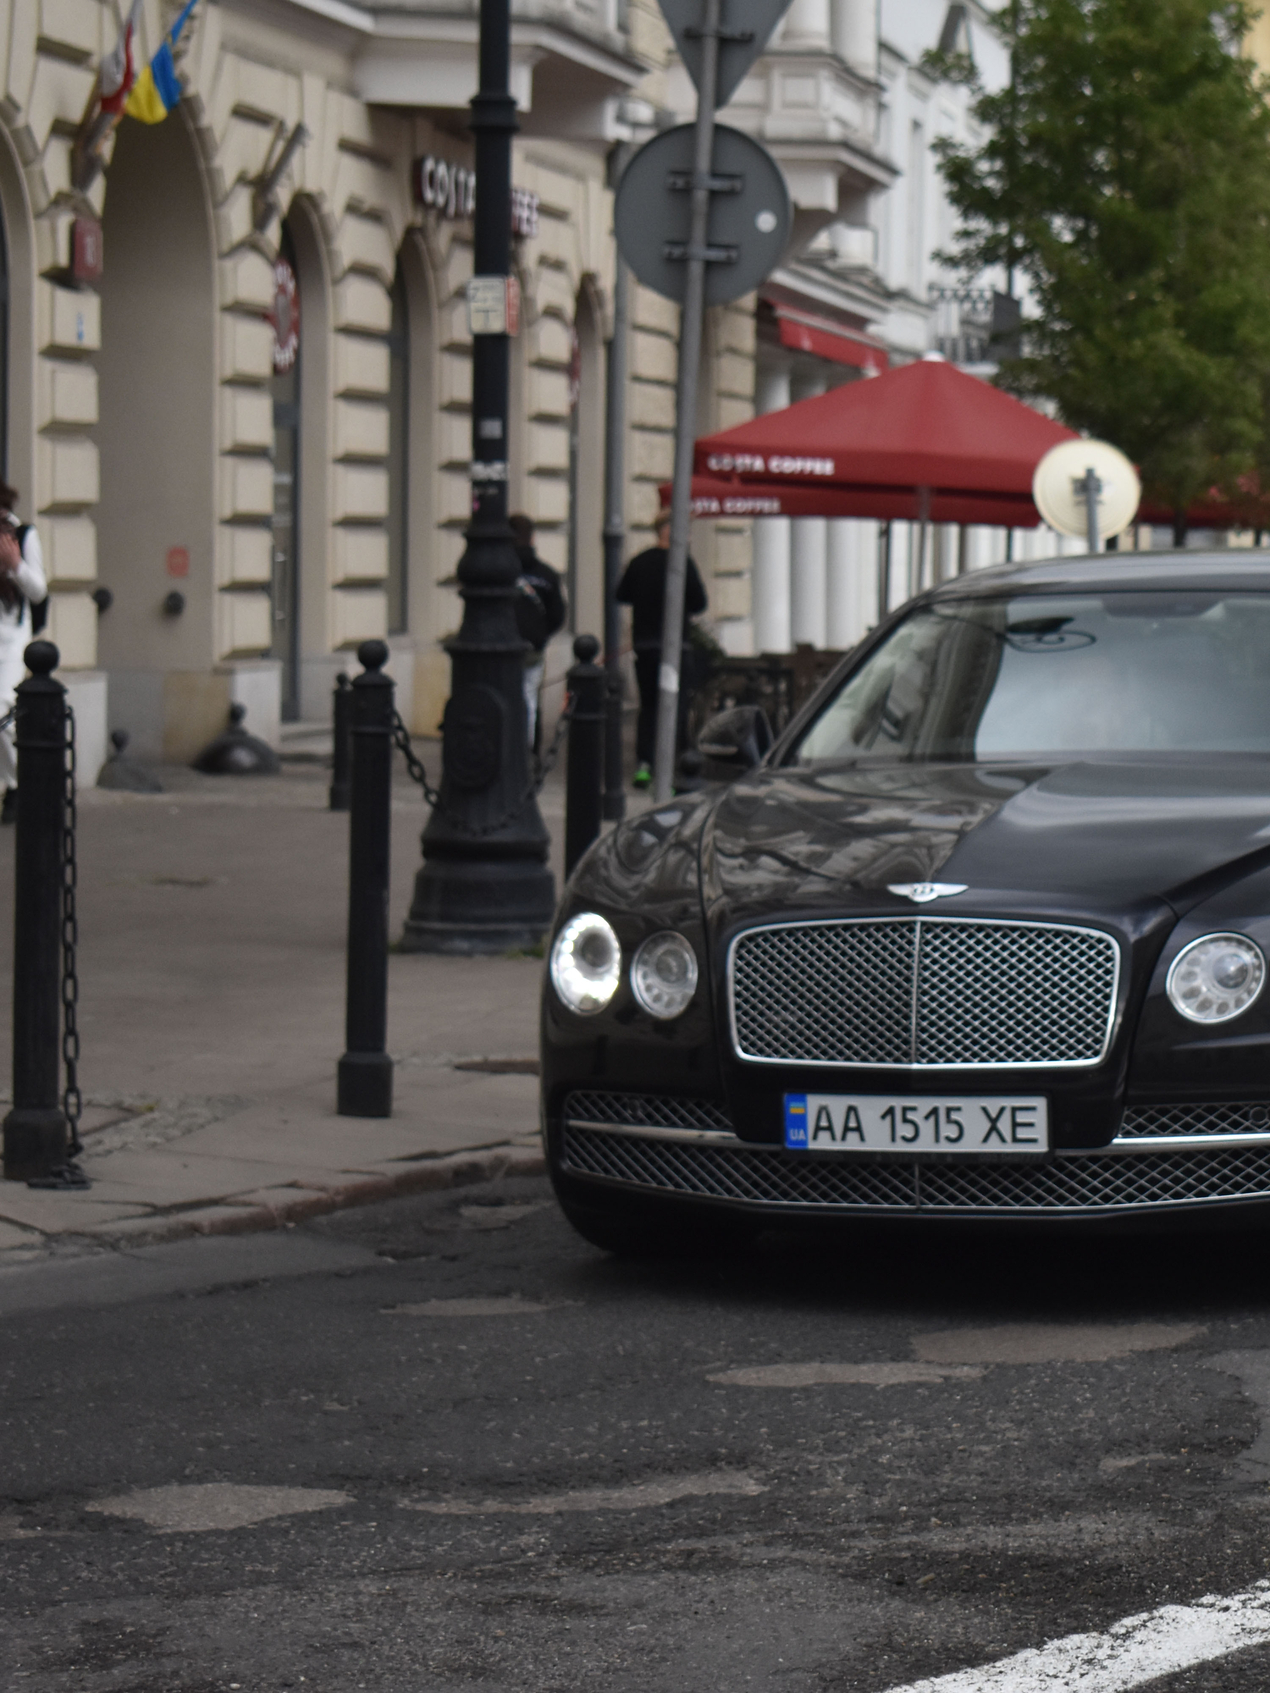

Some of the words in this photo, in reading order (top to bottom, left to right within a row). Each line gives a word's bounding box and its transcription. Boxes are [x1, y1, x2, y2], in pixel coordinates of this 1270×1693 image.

[707, 453, 765, 473] COSTA
[768, 455, 835, 476] COFFEE
[722, 497, 782, 514] COFFEE
[812, 1104, 866, 1142] AA
[880, 1104, 965, 1143] 1515
[980, 1105, 1039, 1144] XE
[789, 1128, 806, 1141] UA
